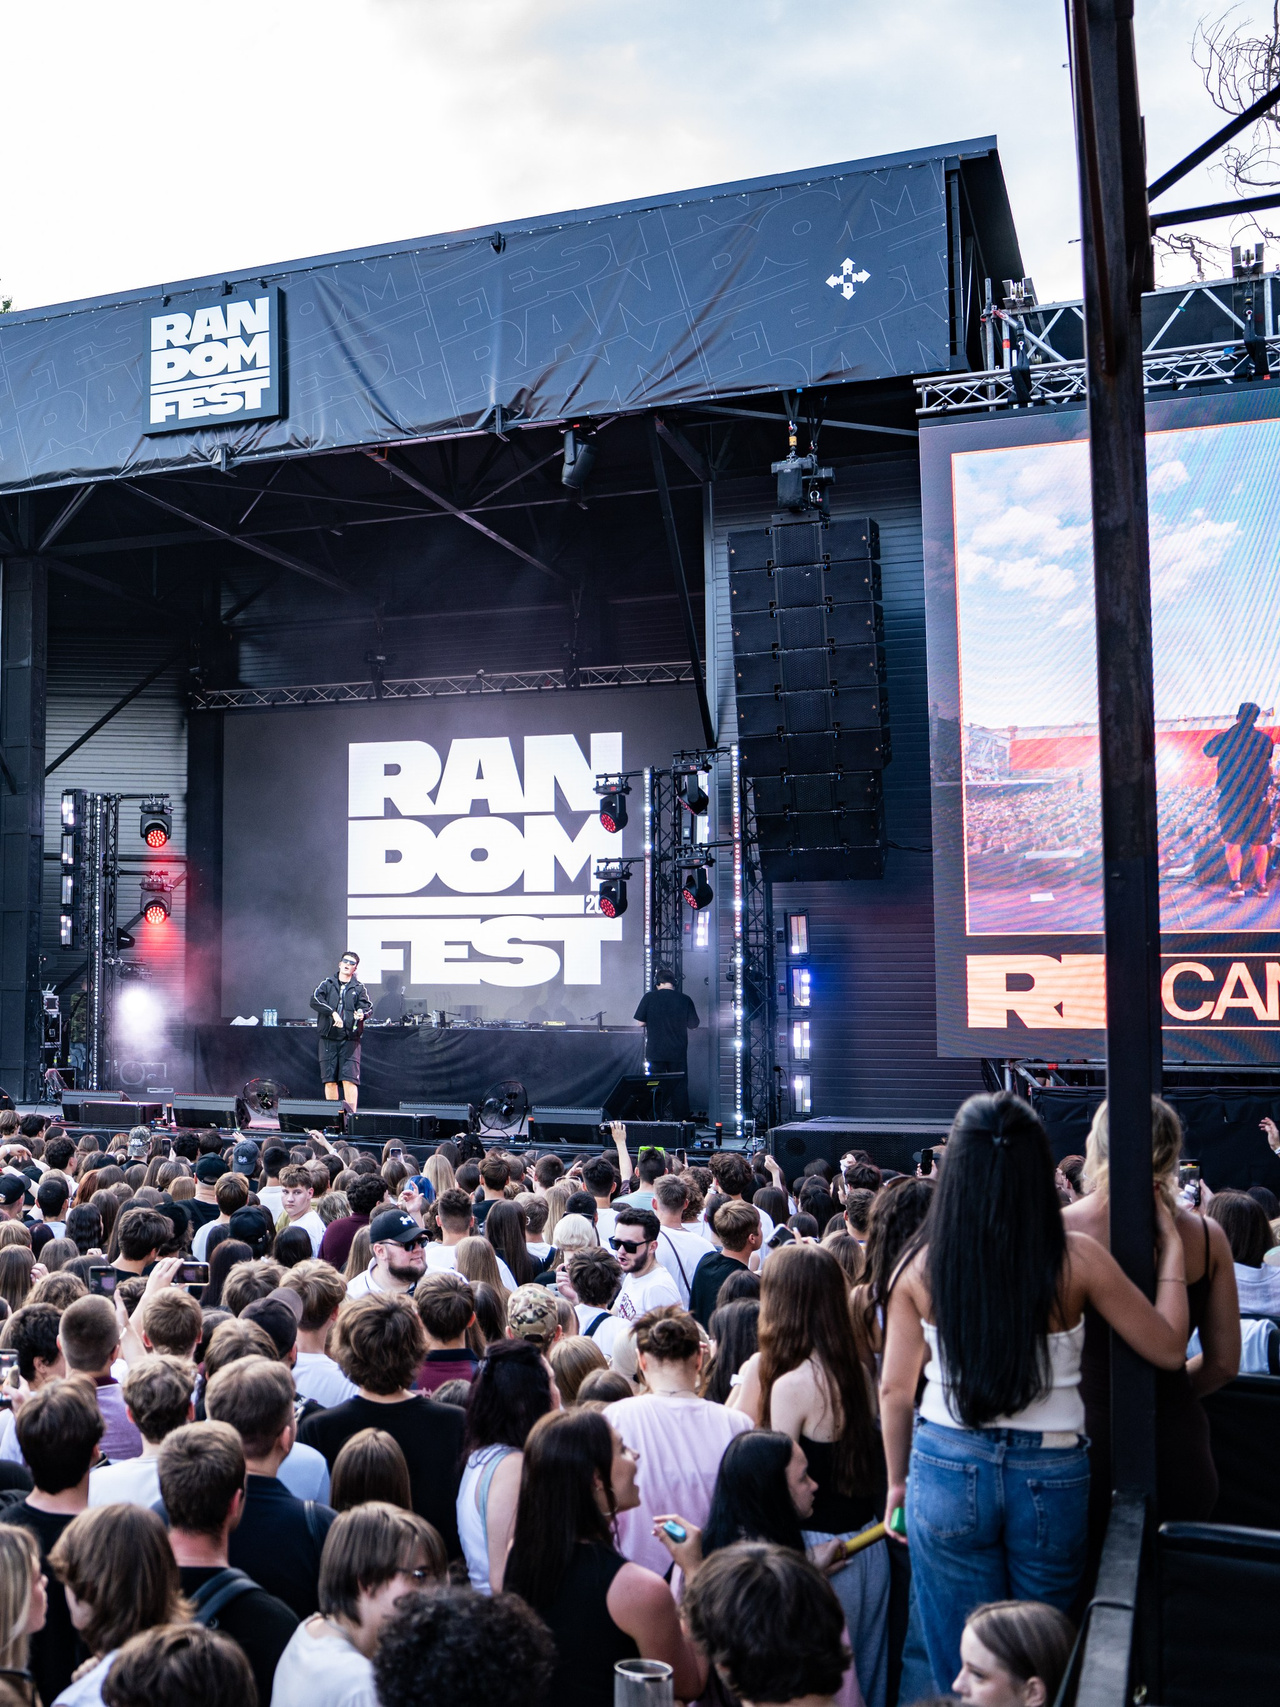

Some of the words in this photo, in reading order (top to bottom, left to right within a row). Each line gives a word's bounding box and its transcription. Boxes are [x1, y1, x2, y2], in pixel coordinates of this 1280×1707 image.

[150, 297, 270, 351] RAN
[150, 331, 270, 385] DOM
[149, 376, 270, 424] FEST
[348, 732, 622, 817] RAN
[347, 813, 622, 895] DOM
[347, 915, 622, 987] FEST
[1161, 961, 1280, 1021] CA
